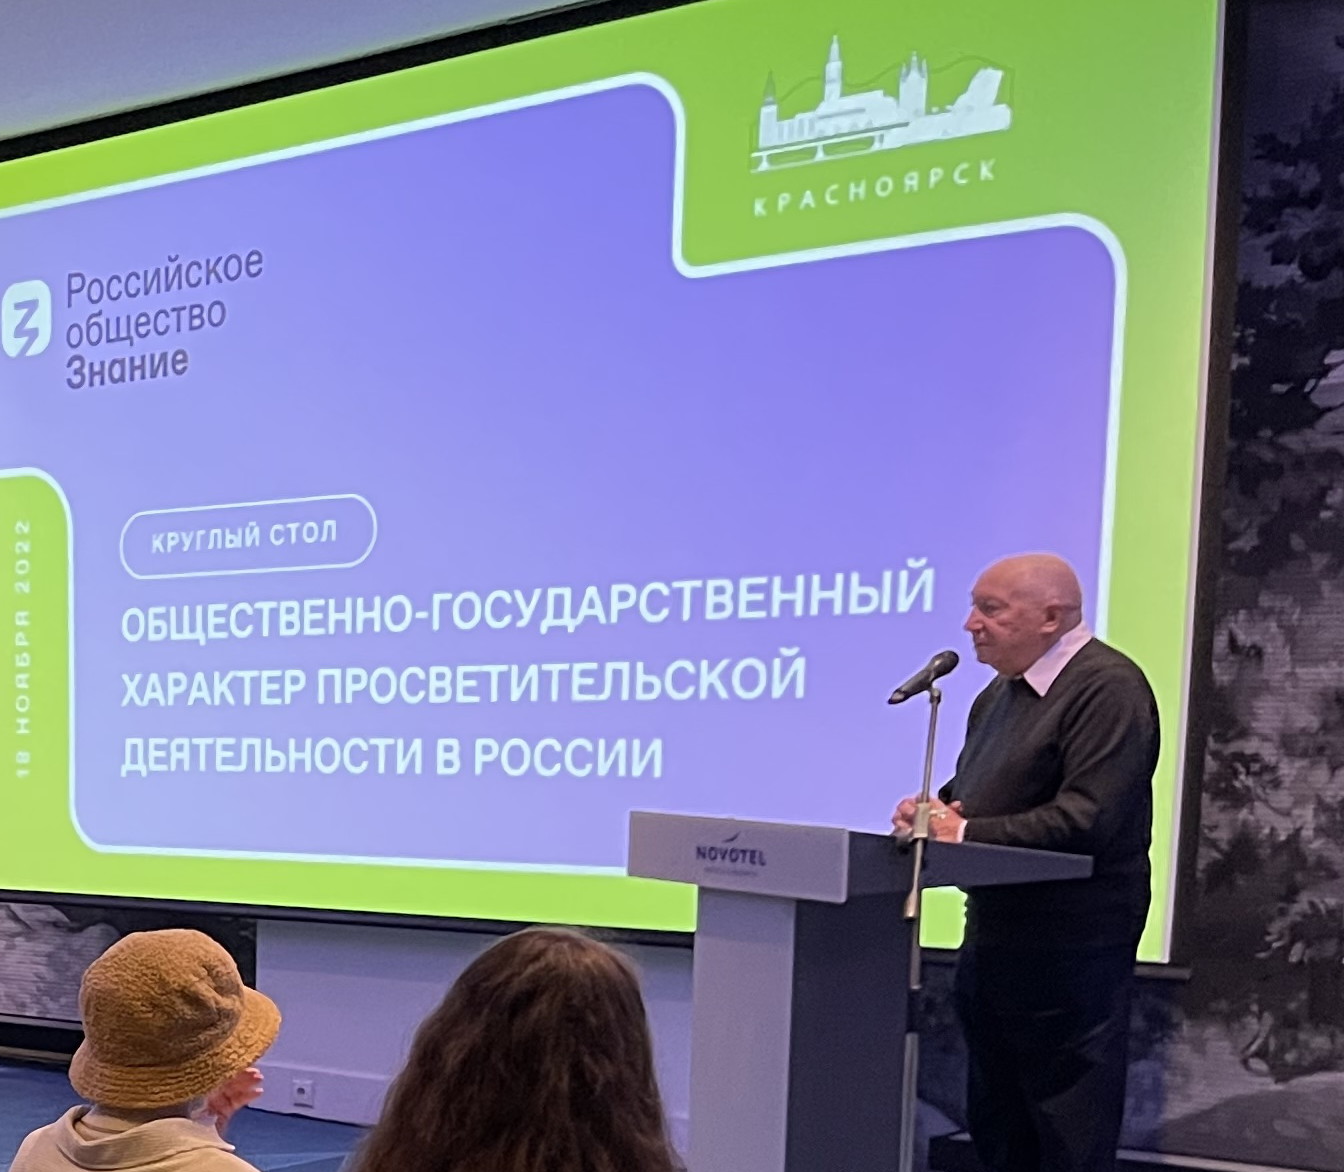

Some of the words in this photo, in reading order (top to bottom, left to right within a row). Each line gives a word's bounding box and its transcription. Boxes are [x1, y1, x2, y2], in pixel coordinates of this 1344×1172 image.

[754, 158, 996, 217] КРАСНОЯРСК
[67, 249, 263, 308] Российское
[66, 299, 226, 349] общество
[66, 348, 189, 390] Знание
[15, 520, 30, 594] 2022
[151, 521, 260, 554] КРУГЛЫЙ
[270, 519, 338, 546] СТОЛ
[121, 557, 935, 646] ОБЩЕСТВЕННО-ГОСУДАРСТВЕННЫЙ
[15, 610, 30, 734] НОЯБРЯ
[121, 668, 307, 707] ХАРАКТЕР
[317, 646, 806, 705] ПРОСВЕТИТЕЛЬСКОЙ
[120, 736, 423, 778] ДЕЯТЕЛЬНОСТИ
[436, 737, 461, 776] В
[475, 737, 663, 778] РОССИИ
[696, 845, 767, 867] NOVOTEL
